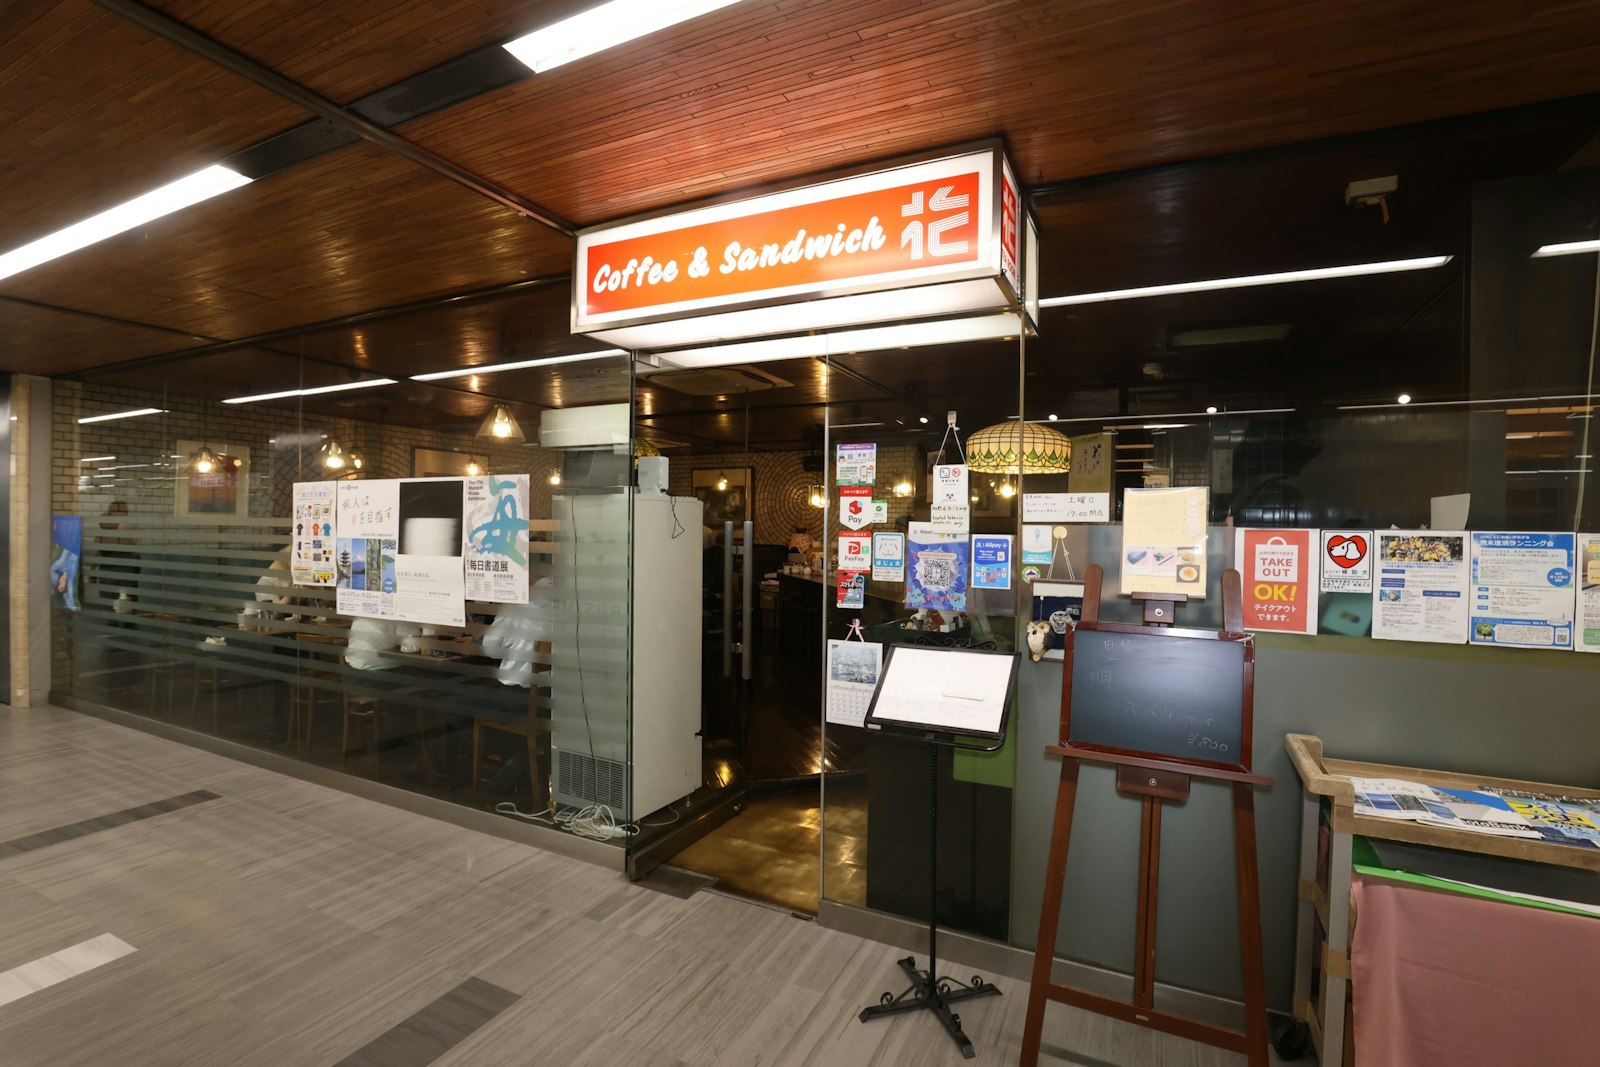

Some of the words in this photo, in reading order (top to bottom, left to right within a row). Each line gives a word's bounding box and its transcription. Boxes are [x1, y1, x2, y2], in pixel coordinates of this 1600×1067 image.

[592, 258, 678, 294] Coffee
[687, 246, 710, 279] &
[719, 215, 887, 273] Sandwich
[848, 516, 862, 524] Pay
[470, 560, 509, 572] 毎日書道展
[1260, 558, 1293, 567] TAKE
[1262, 568, 1290, 577] OUT
[1254, 583, 1297, 601] OK!
[1254, 604, 1297, 613] テイクアウト
[1258, 614, 1290, 622] できます。
